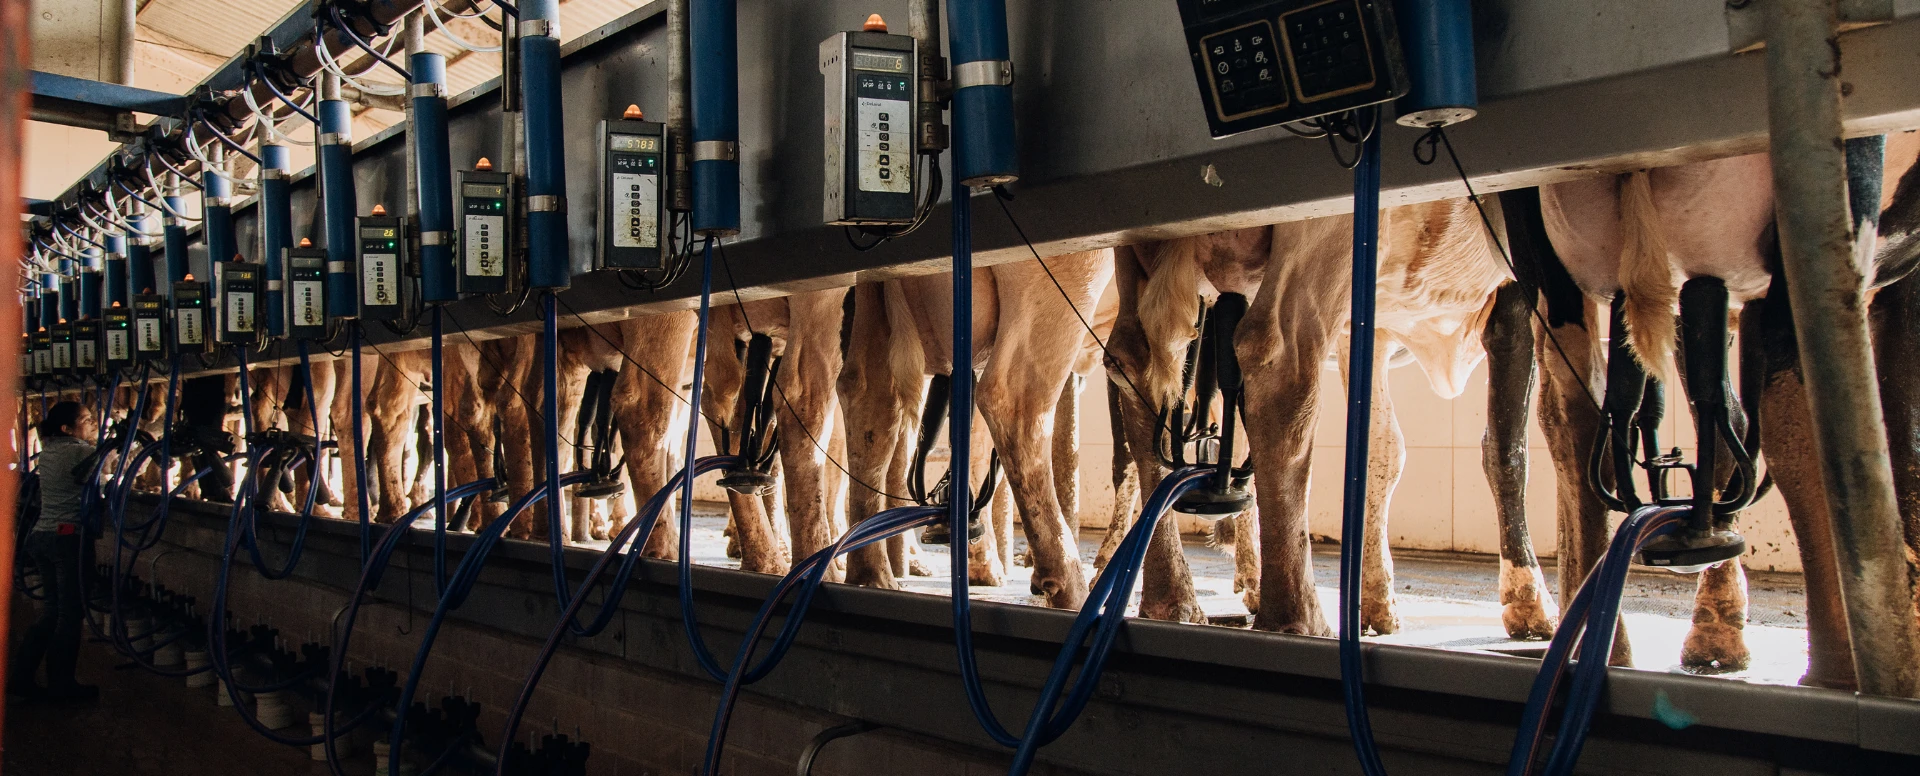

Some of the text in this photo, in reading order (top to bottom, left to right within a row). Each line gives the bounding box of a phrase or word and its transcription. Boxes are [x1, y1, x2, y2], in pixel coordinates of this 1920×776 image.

[1297, 12, 1345, 31] 7 8 9
[1322, 36, 1328, 44] 5
[1343, 31, 1349, 39] 6
[627, 139, 654, 150] 5783
